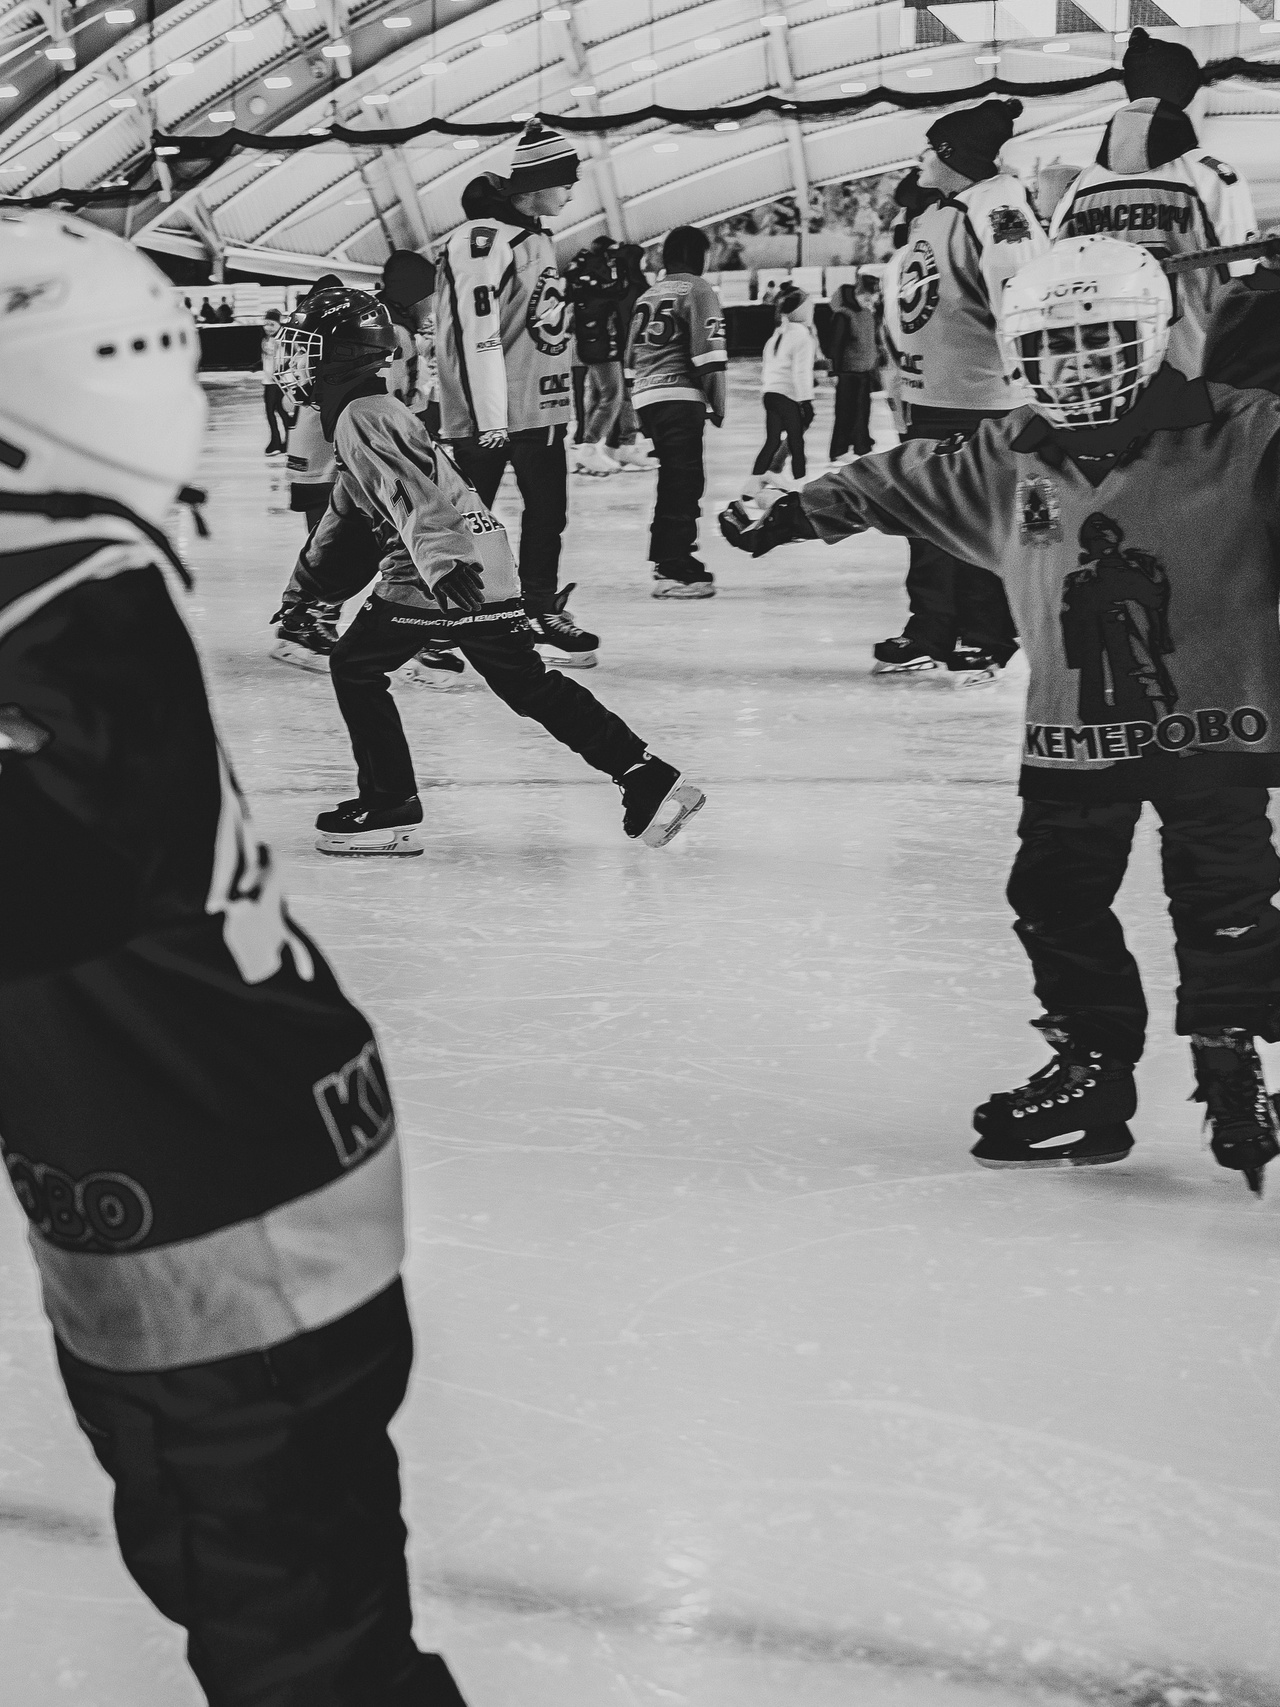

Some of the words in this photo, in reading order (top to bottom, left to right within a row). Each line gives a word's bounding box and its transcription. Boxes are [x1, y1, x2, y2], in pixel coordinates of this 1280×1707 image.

[1041, 280, 1098, 301] JOFA
[321, 302, 351, 319] JOFA
[631, 298, 680, 347] 25
[1023, 705, 1269, 762] КЕМЕРОВО
